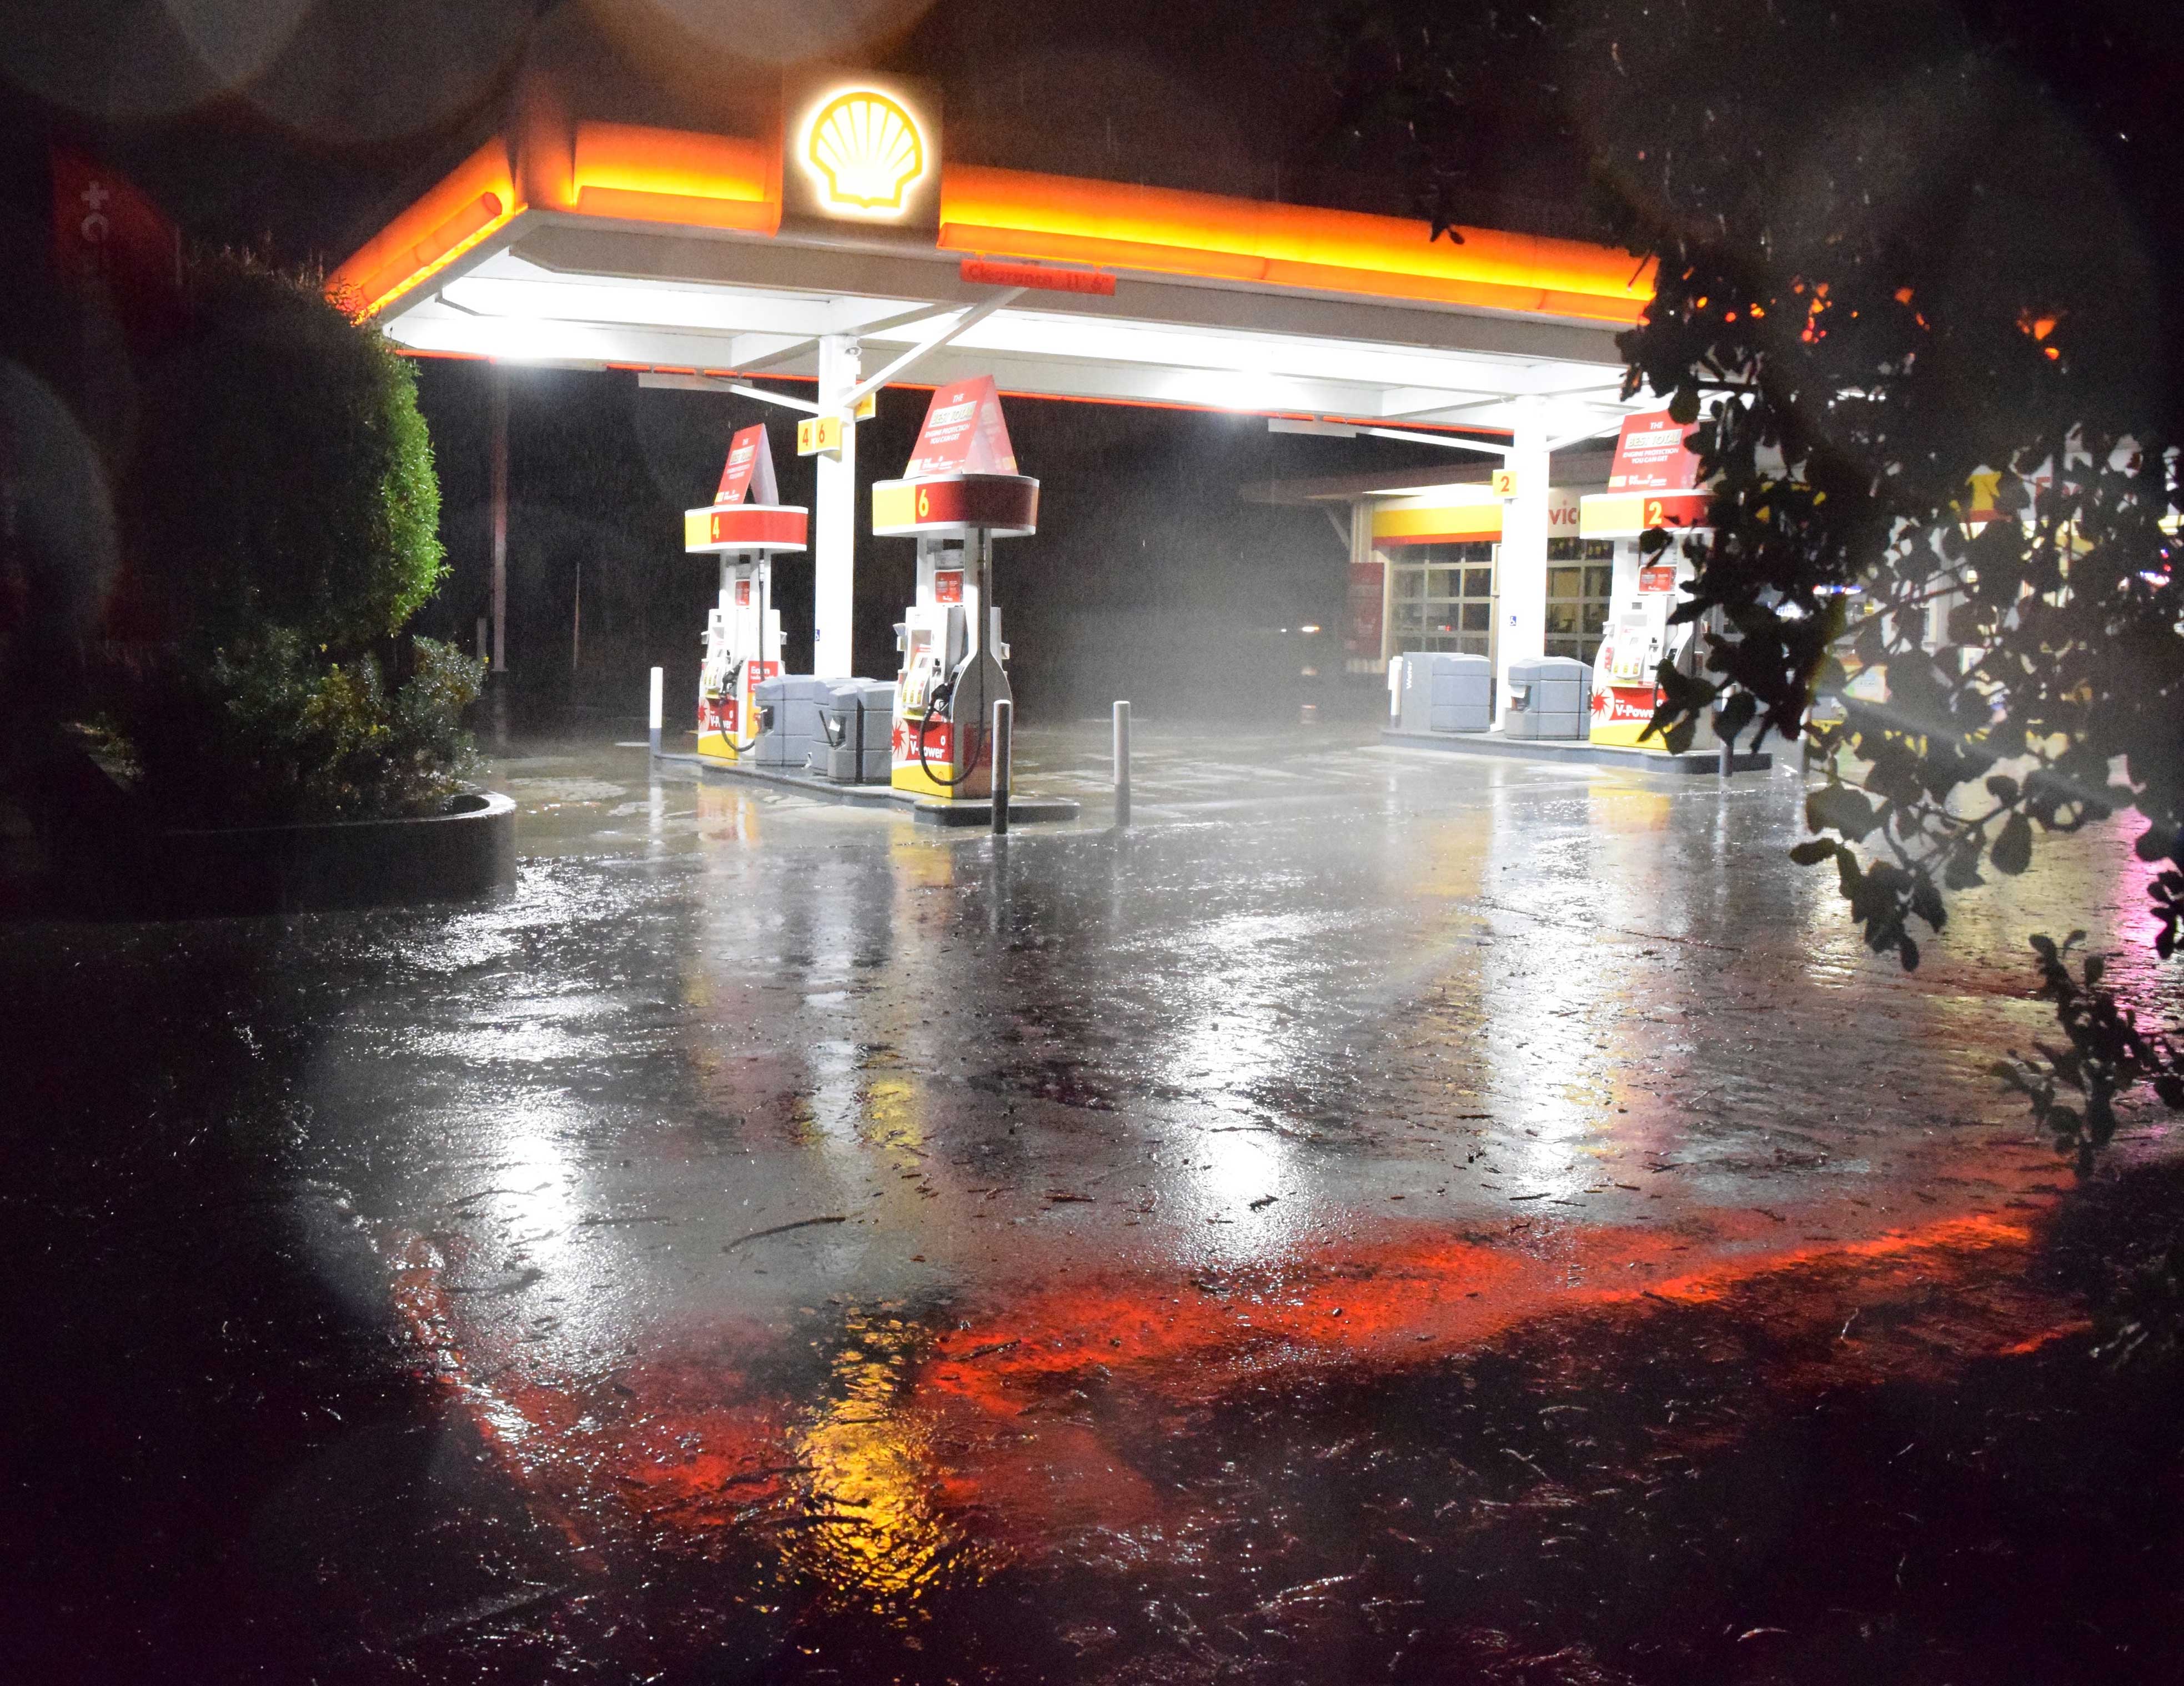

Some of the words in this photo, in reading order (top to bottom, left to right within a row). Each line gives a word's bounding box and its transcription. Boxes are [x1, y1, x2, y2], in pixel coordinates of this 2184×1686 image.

[968, 263, 1053, 288] Clearance
[953, 393, 964, 403] THE
[802, 428, 809, 446] 4
[819, 424, 825, 443] 6
[1628, 435, 1650, 446] BEST
[1651, 433, 1678, 444] TOTAL
[1500, 476, 1509, 492] 2
[918, 489, 929, 517] 6
[1548, 500, 1580, 525] vic
[1649, 501, 1662, 525] 2
[712, 516, 720, 539] 4
[1615, 704, 1654, 718] V-Powe
[711, 715, 732, 729] V-Pwer
[910, 740, 945, 759] V-ower
